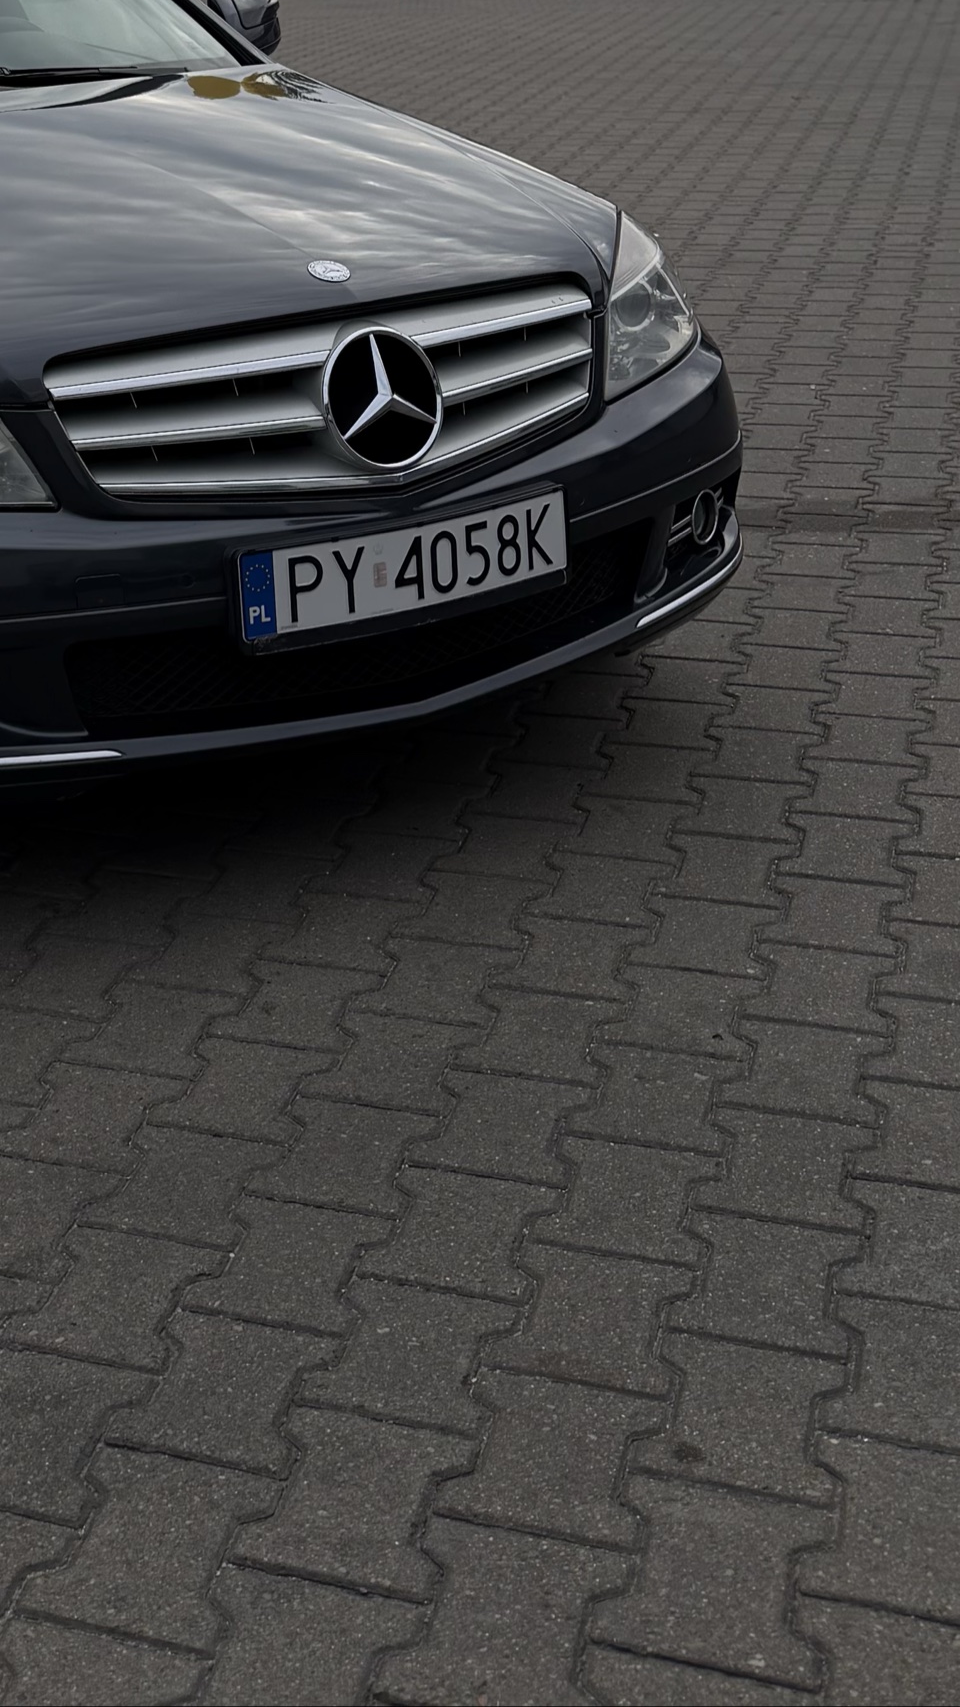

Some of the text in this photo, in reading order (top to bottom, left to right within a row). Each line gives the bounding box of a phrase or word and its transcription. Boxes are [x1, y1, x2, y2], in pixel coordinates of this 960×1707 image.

[287, 503, 554, 623] PY 4058K
[248, 604, 271, 625] PL
